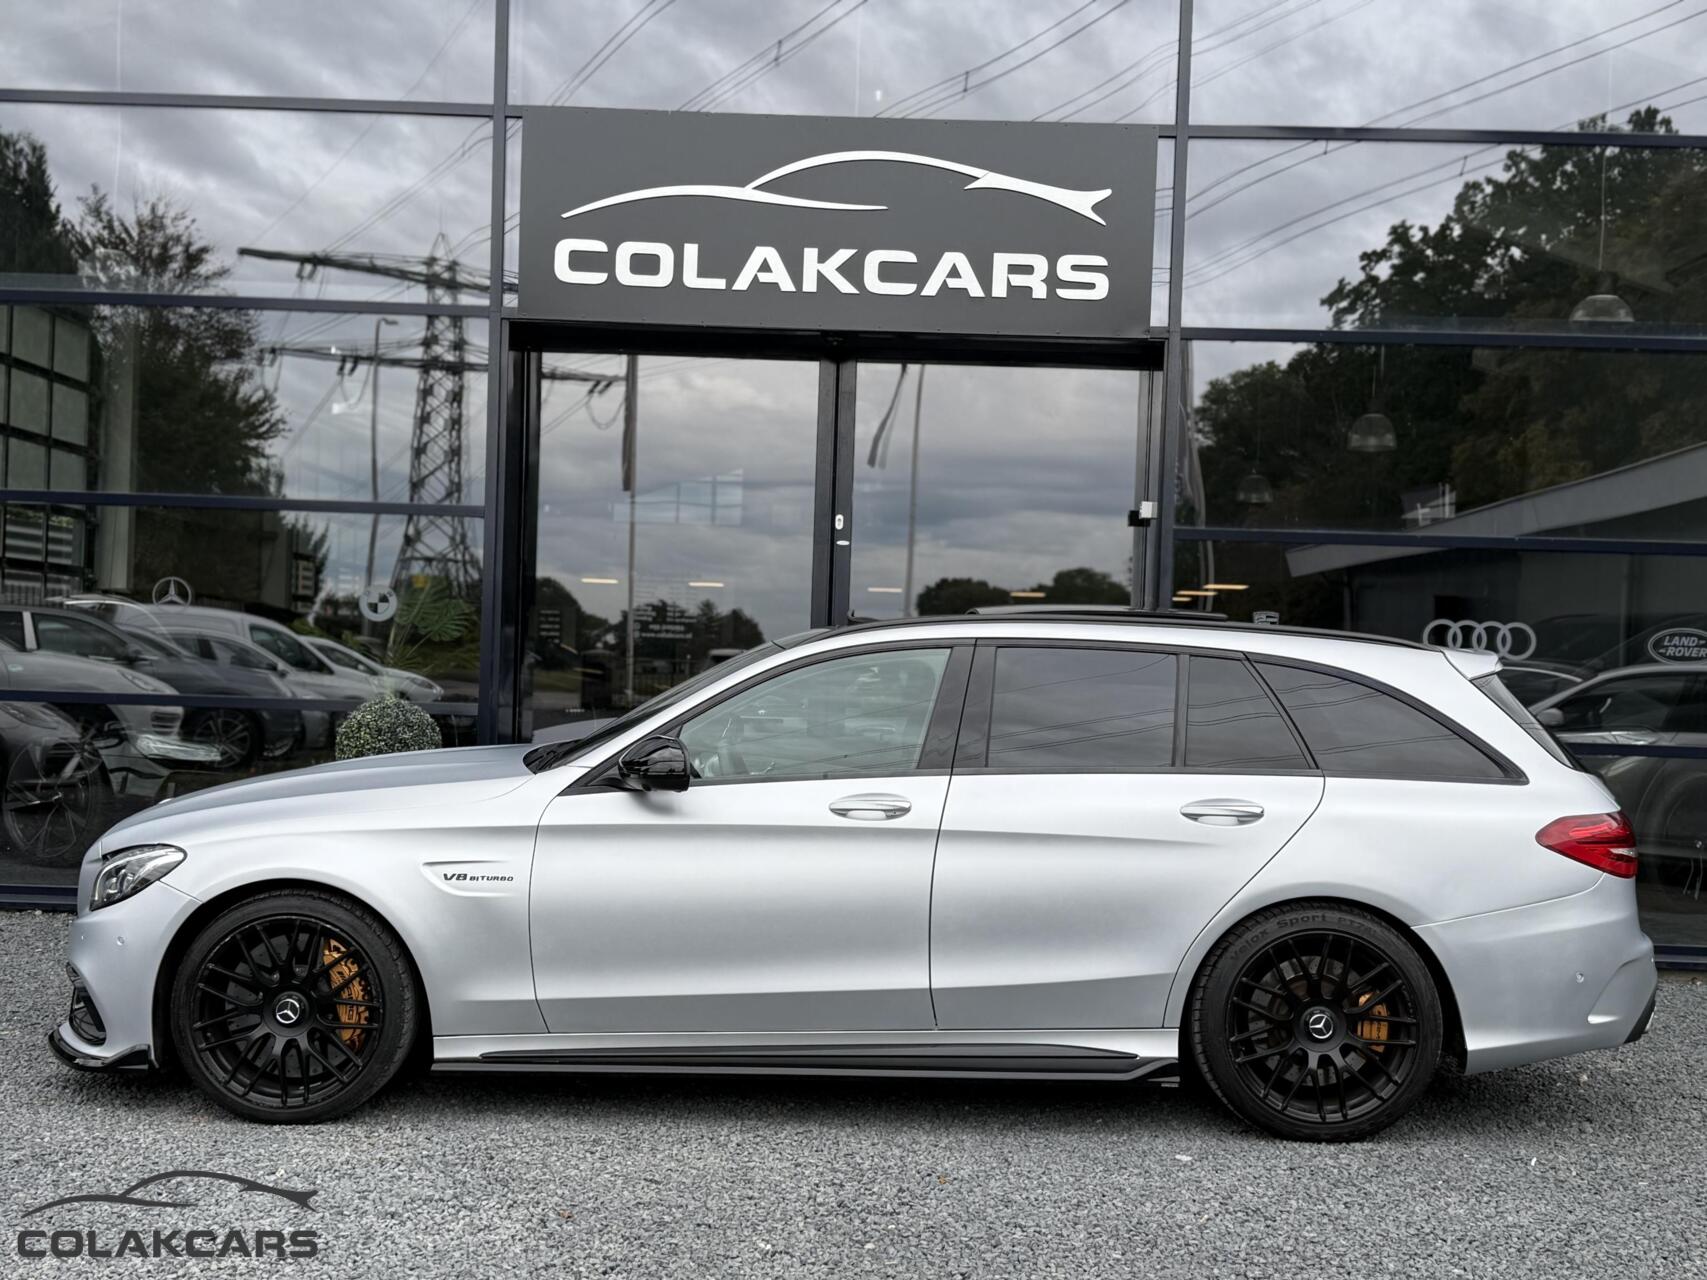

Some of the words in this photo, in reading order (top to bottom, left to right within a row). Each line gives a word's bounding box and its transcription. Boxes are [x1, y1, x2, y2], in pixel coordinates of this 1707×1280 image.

[553, 238, 1110, 301] COLAKCARS
[1664, 636, 1698, 646] LAND
[1666, 647, 1707, 657] ROVER
[444, 873, 468, 881] V8
[1276, 914, 1326, 929] Sport
